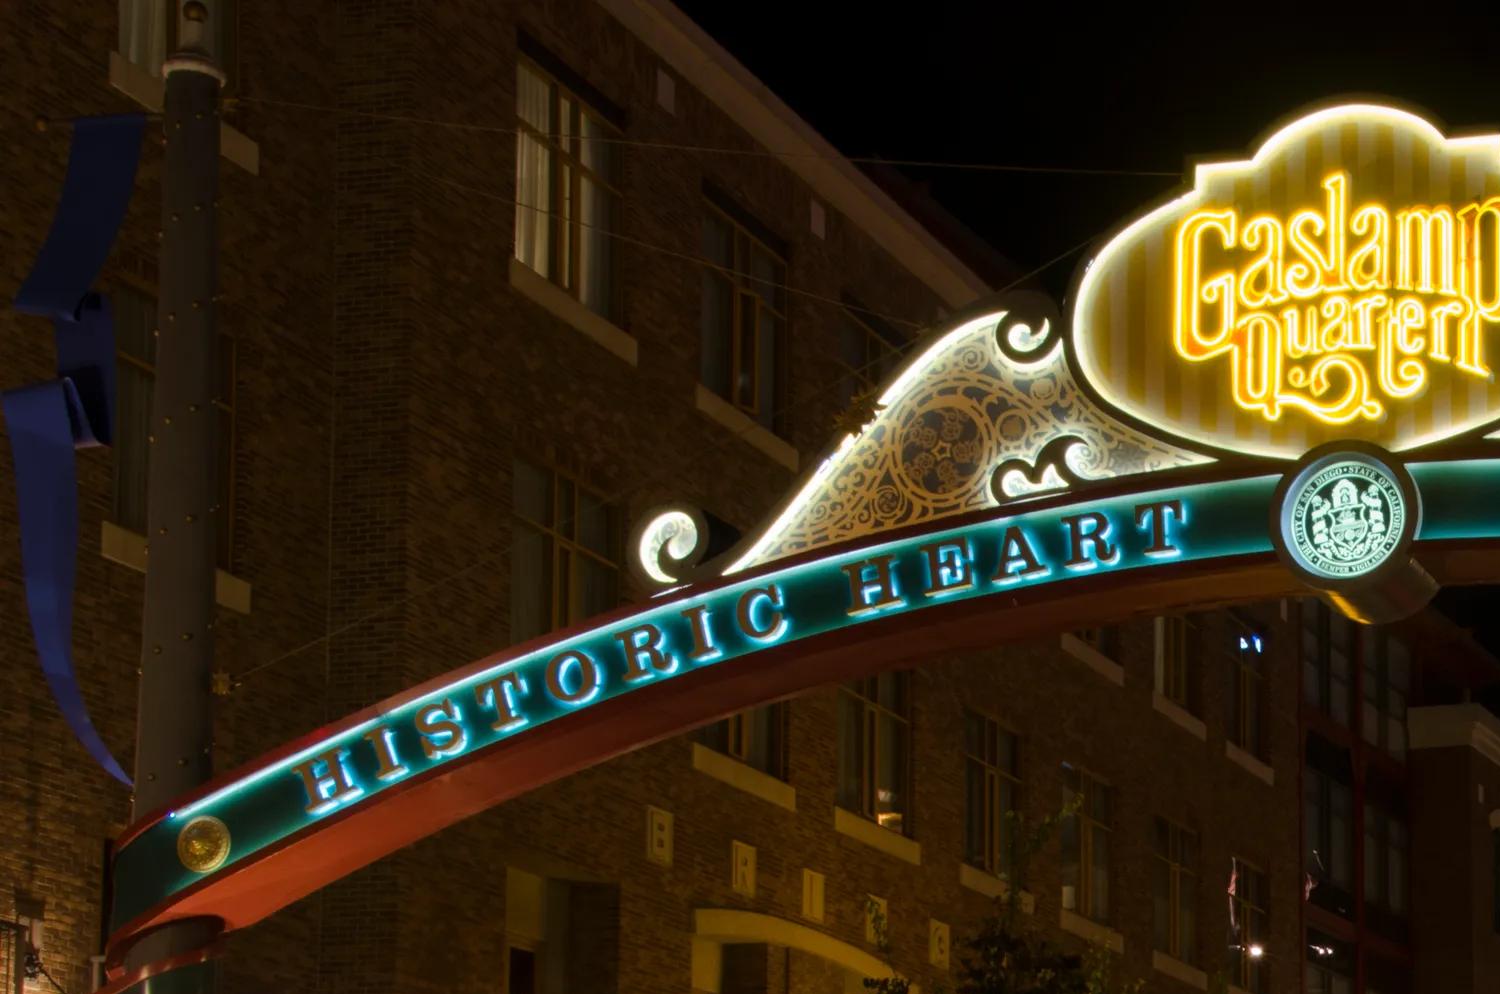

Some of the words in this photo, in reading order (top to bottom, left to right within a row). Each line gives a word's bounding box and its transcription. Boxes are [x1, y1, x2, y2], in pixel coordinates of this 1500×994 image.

[1232, 293, 1492, 424] Quarter
[1315, 468, 1343, 487] DIEGO
[1348, 465, 1377, 480] STATE
[1378, 477, 1391, 489] OF
[1300, 484, 1316, 504] SAN
[1295, 503, 1306, 518] OF
[1387, 488, 1401, 543] CALIFORNIA
[1295, 520, 1305, 543] CITY
[1300, 541, 1316, 559] THE
[293, 585, 787, 815] HISTORIC
[842, 499, 1184, 617] HEART
